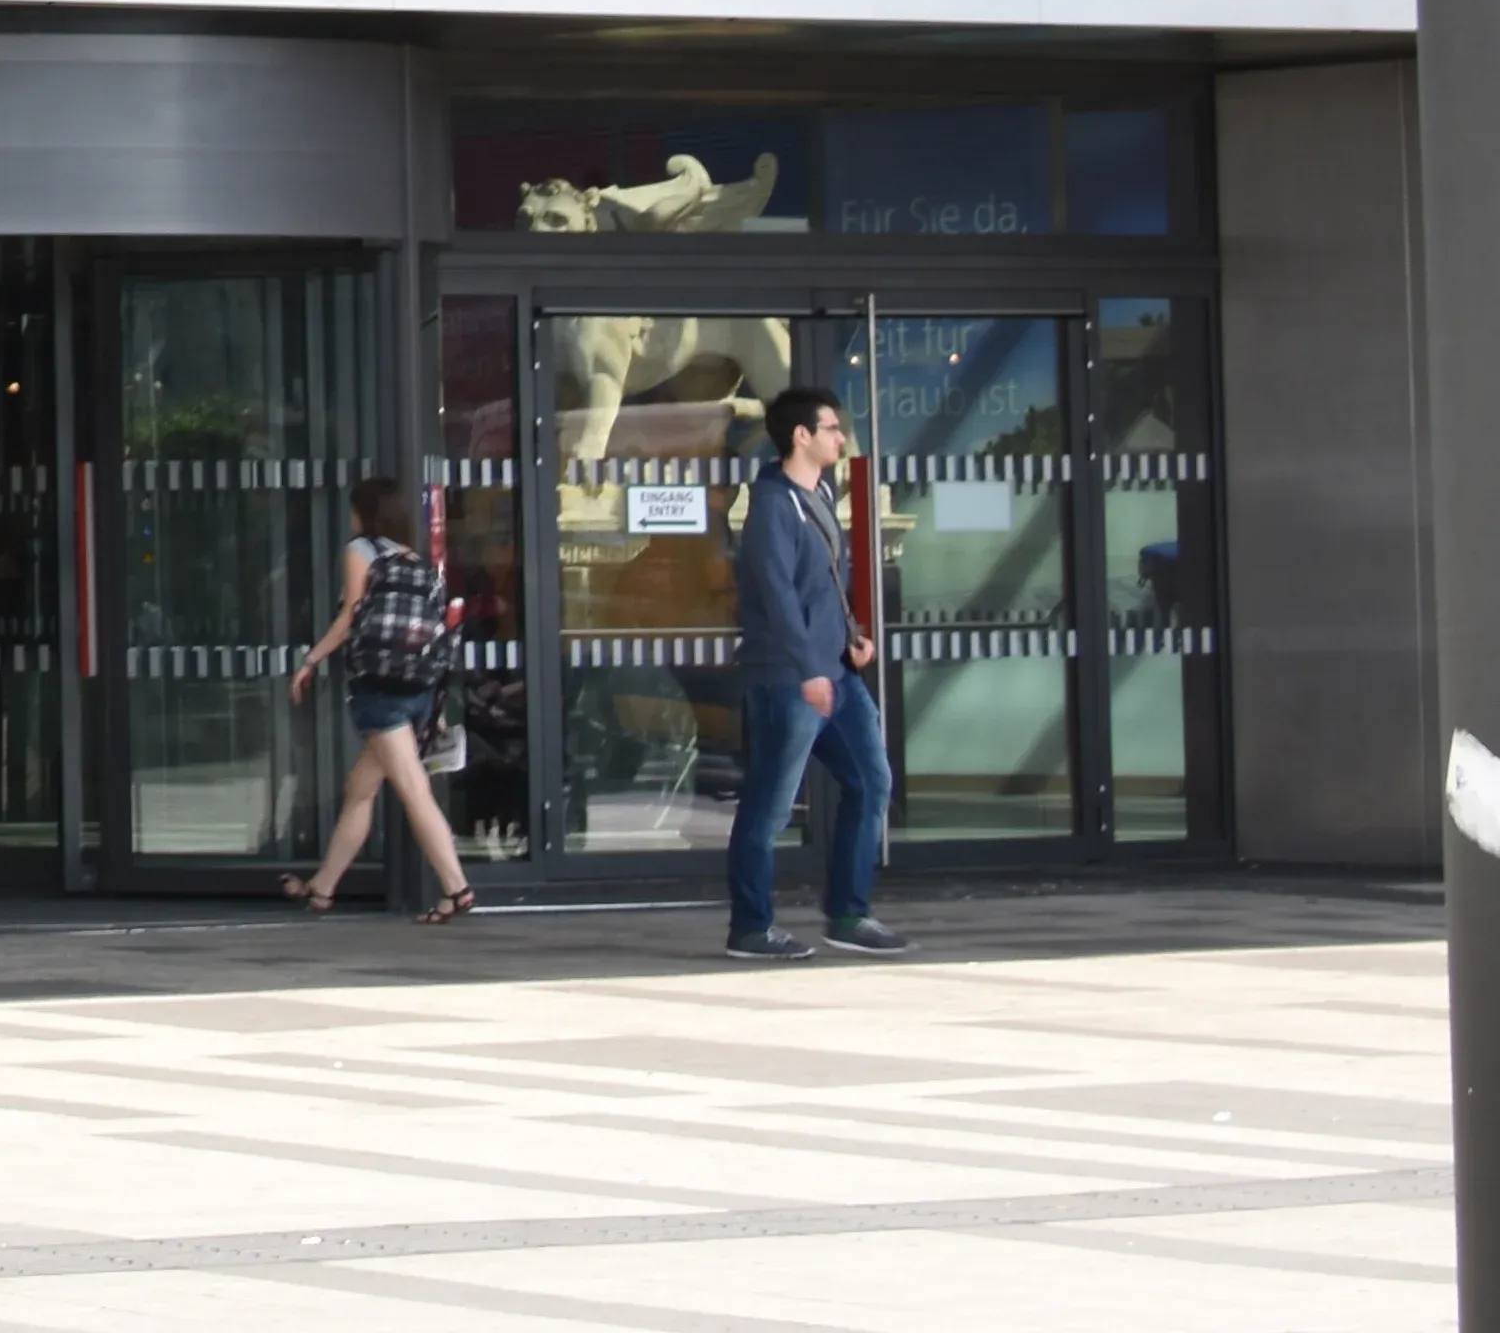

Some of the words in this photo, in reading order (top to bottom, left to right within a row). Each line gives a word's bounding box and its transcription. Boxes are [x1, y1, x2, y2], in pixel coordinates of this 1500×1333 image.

[840, 198, 896, 234] Für
[909, 194, 961, 234] Sie
[640, 491, 694, 504] EINGANG
[649, 505, 686, 516] ENTRY
